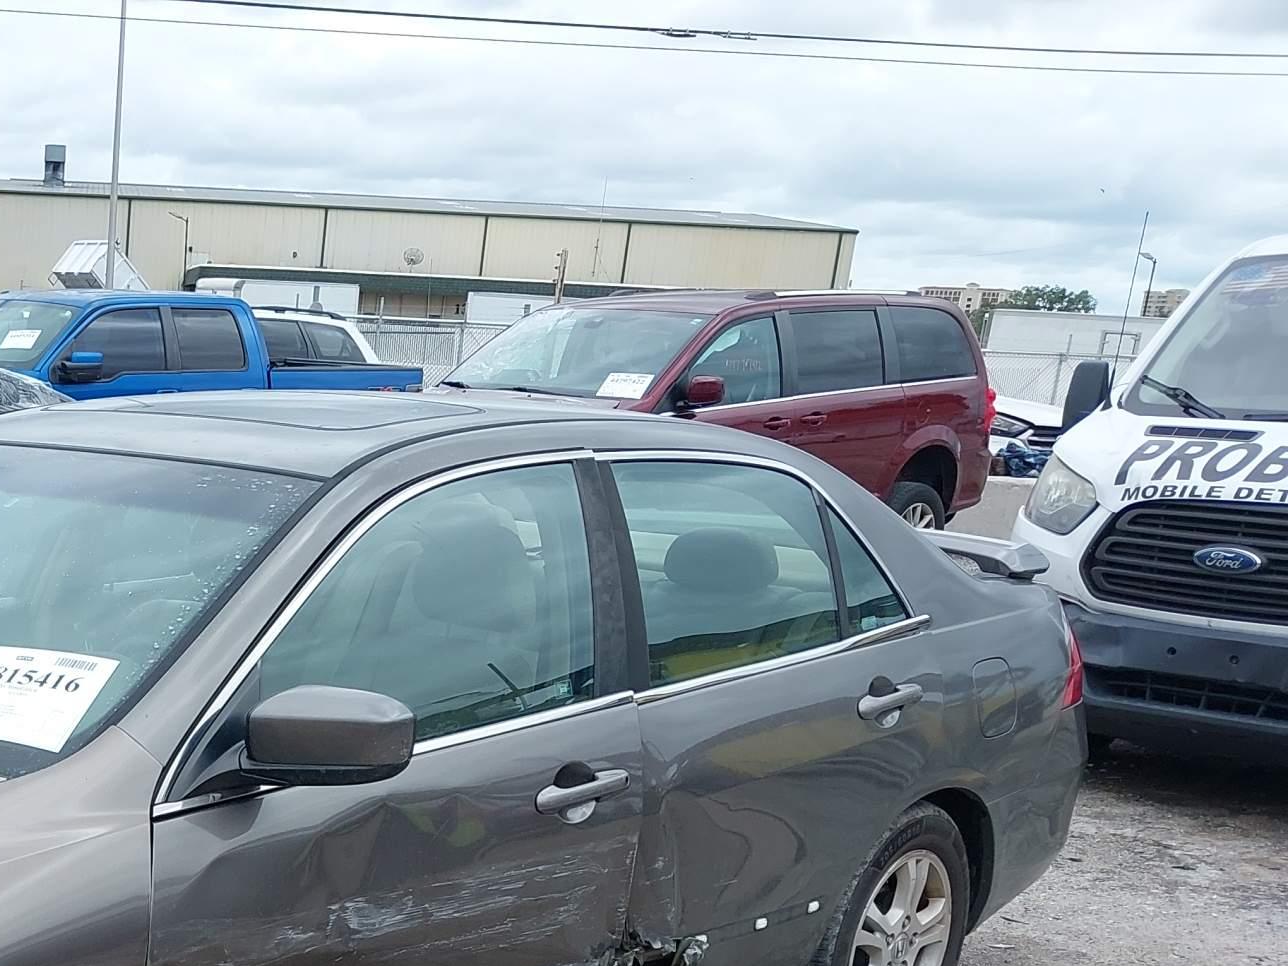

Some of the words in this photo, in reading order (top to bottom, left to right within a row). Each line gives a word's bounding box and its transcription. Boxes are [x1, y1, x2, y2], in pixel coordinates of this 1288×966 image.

[1114, 439, 1288, 485] PROB
[1120, 485, 1226, 501] MOBILE
[1233, 487, 1288, 502] DET
[1205, 551, 1244, 570] Ford
